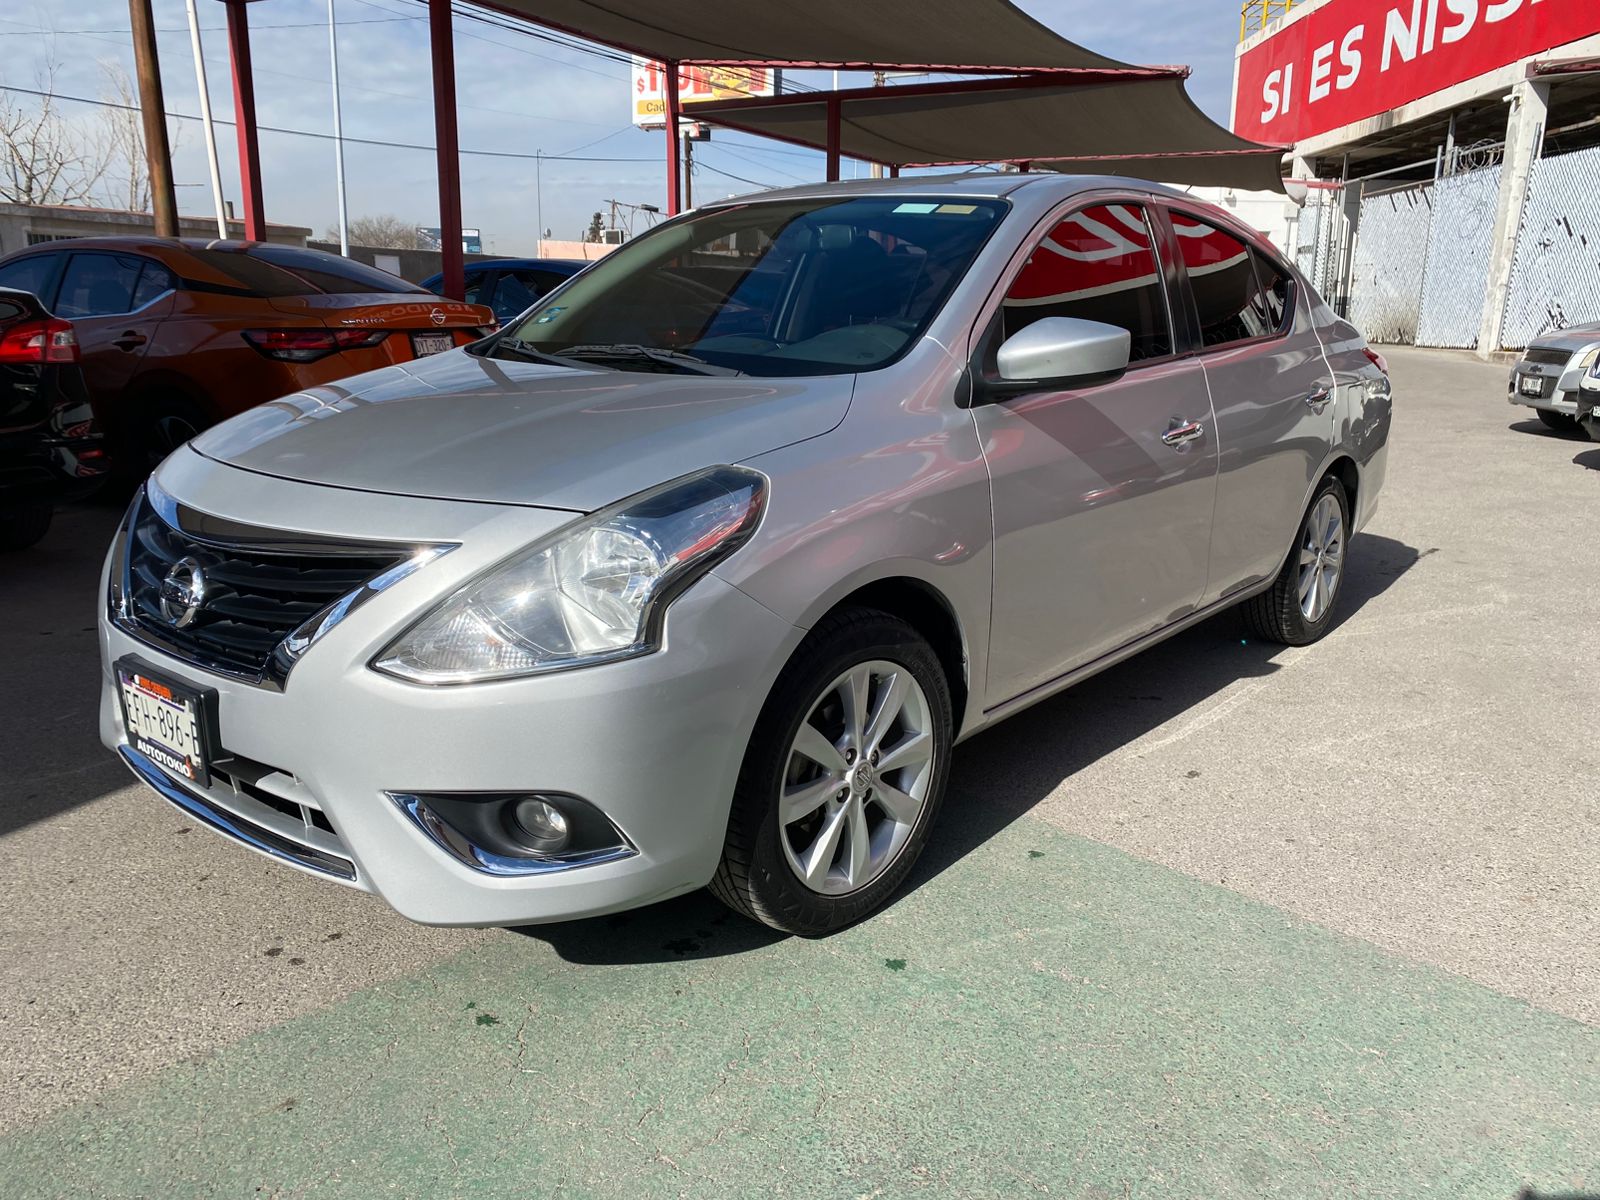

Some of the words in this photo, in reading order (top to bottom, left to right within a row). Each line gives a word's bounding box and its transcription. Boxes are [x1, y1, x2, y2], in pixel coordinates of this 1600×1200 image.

[1260, 63, 1294, 125] SI
[1309, 24, 1365, 105] ES
[137, 739, 192, 778] AUTOTOKIO
